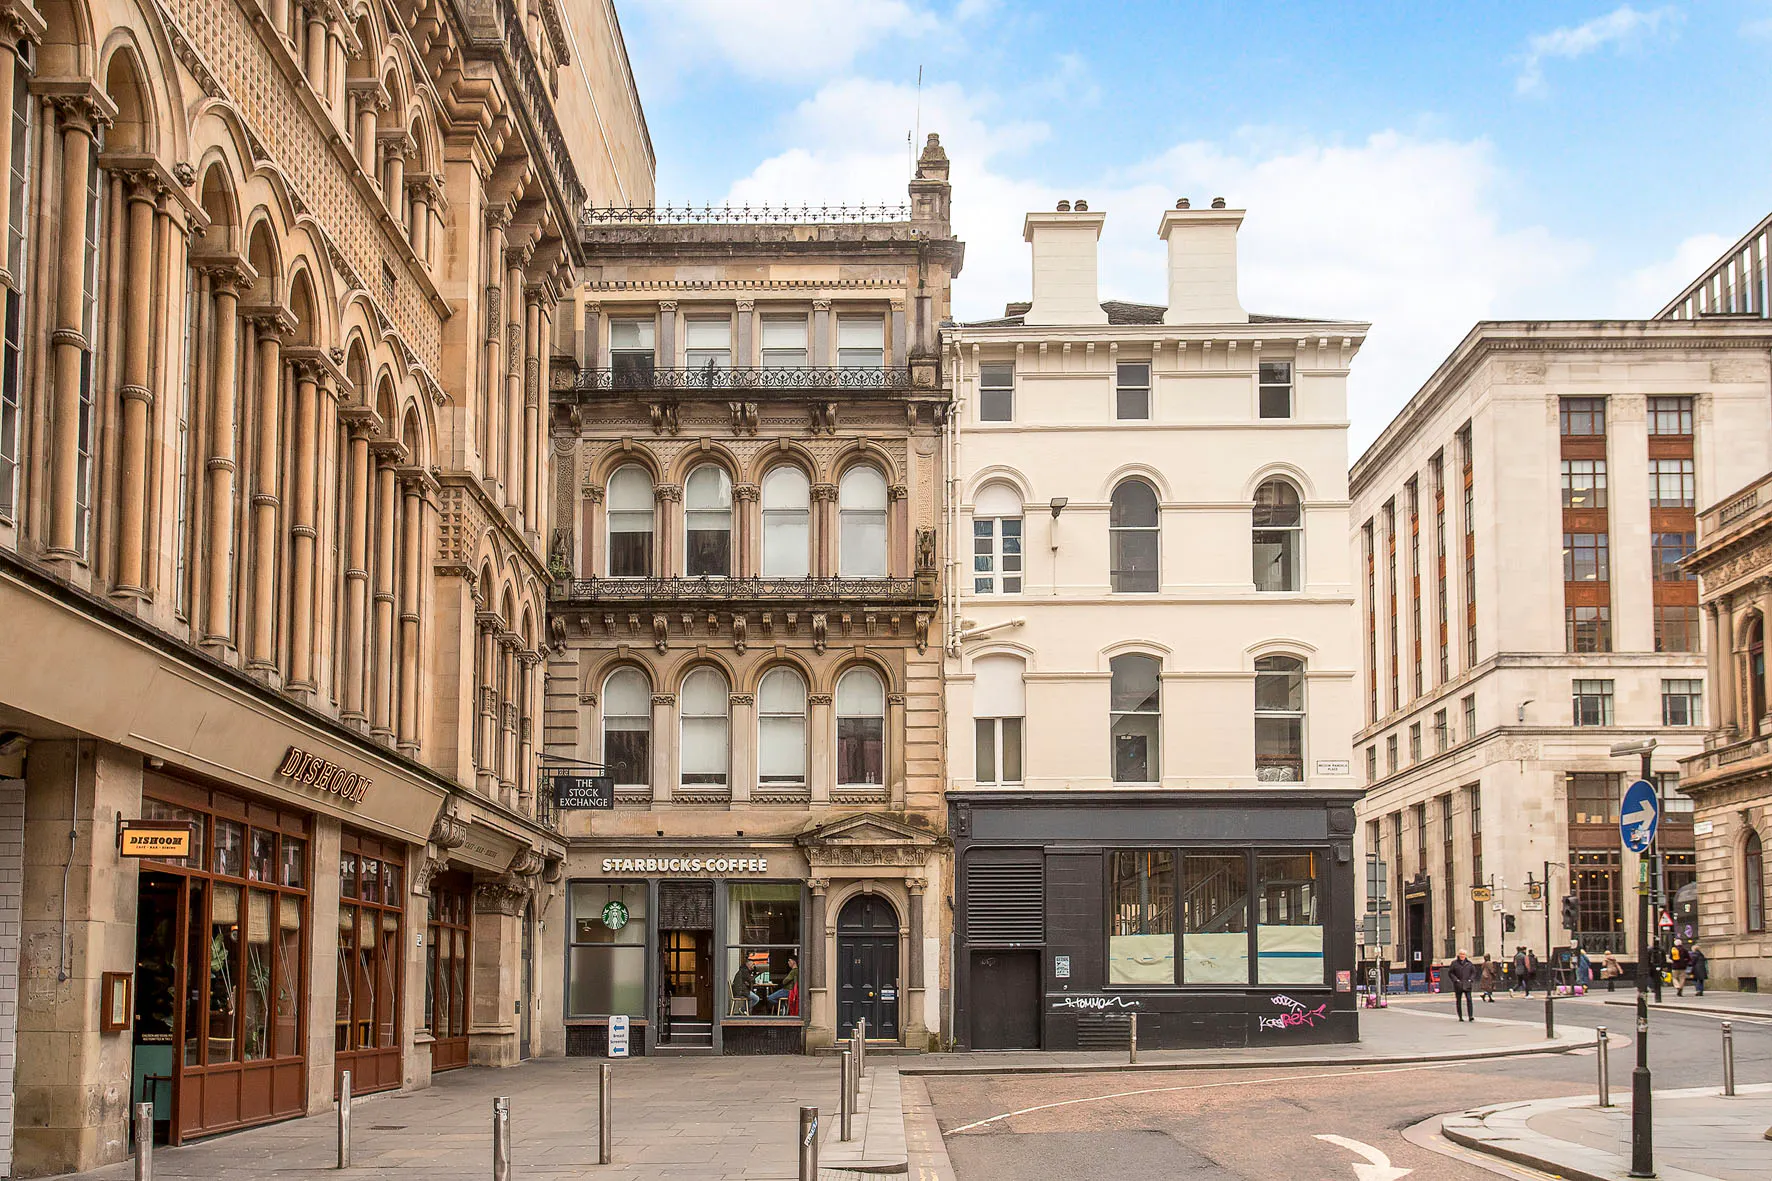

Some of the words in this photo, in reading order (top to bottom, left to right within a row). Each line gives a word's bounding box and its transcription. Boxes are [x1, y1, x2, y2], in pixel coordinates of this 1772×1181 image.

[281, 747, 374, 805] DISHOOM
[575, 779, 593, 788] THE
[568, 788, 599, 797] STOCK
[559, 797, 608, 807] EXCHANGE
[130, 836, 183, 845] DISHOOM
[602, 858, 701, 872] STARBUCKS
[705, 858, 768, 872] COFFEE
